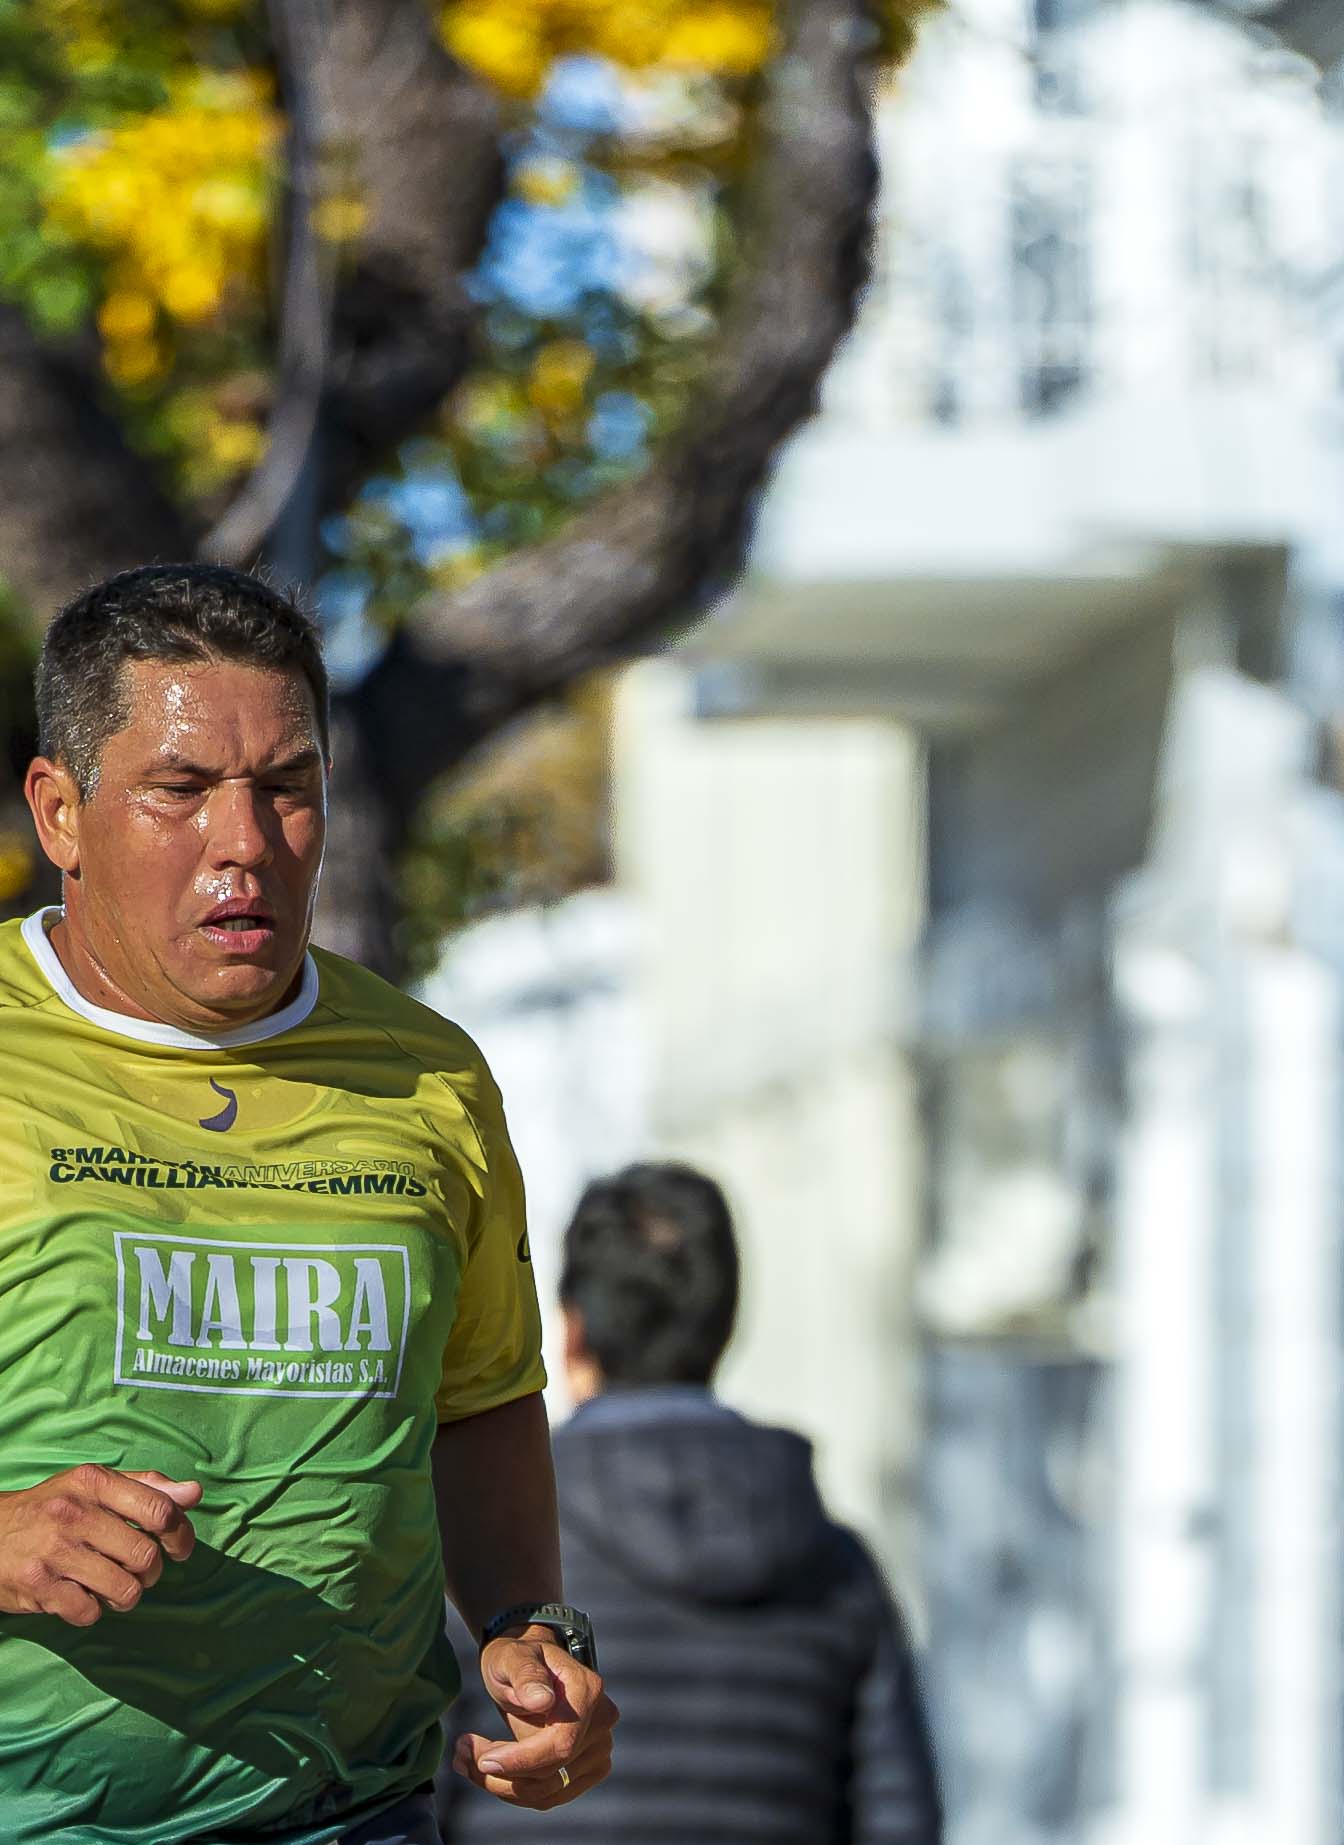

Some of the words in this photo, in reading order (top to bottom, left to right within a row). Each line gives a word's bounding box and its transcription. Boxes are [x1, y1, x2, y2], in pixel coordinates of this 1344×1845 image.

[134, 1246, 392, 1351] MAIRA
[133, 1348, 241, 1380] Almacenes
[246, 1357, 354, 1385] Mayoristas
[359, 1358, 388, 1384] S.A.
